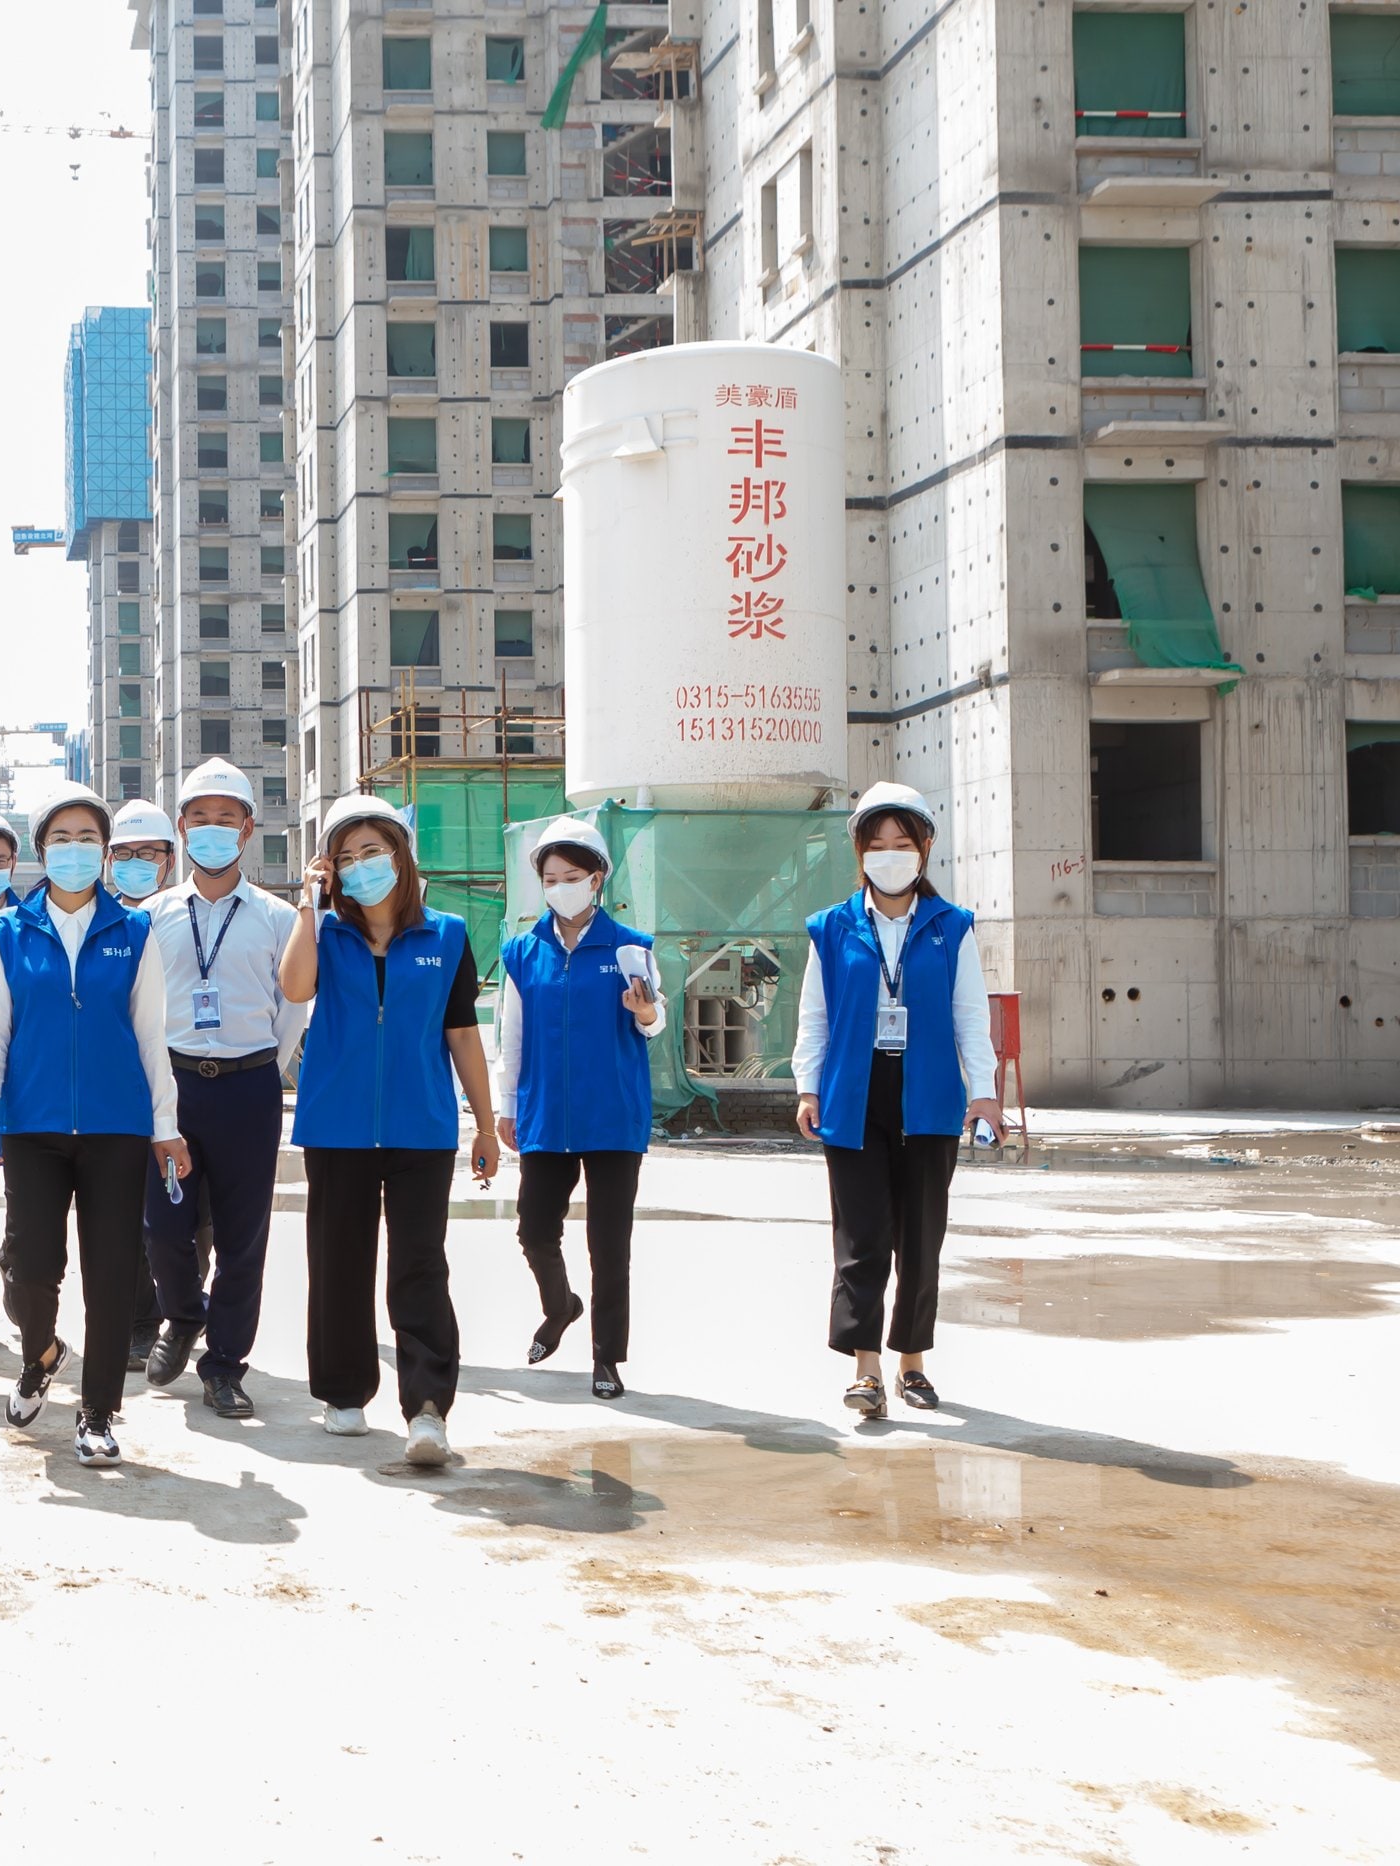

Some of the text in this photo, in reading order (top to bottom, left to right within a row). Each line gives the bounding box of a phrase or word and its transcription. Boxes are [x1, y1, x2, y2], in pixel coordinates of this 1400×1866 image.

[715, 384, 798, 409] 美豪盾
[725, 418, 788, 641] 丰邦砂浆
[676, 685, 821, 712] 0315-5163555
[677, 717, 822, 744] 15131520000
